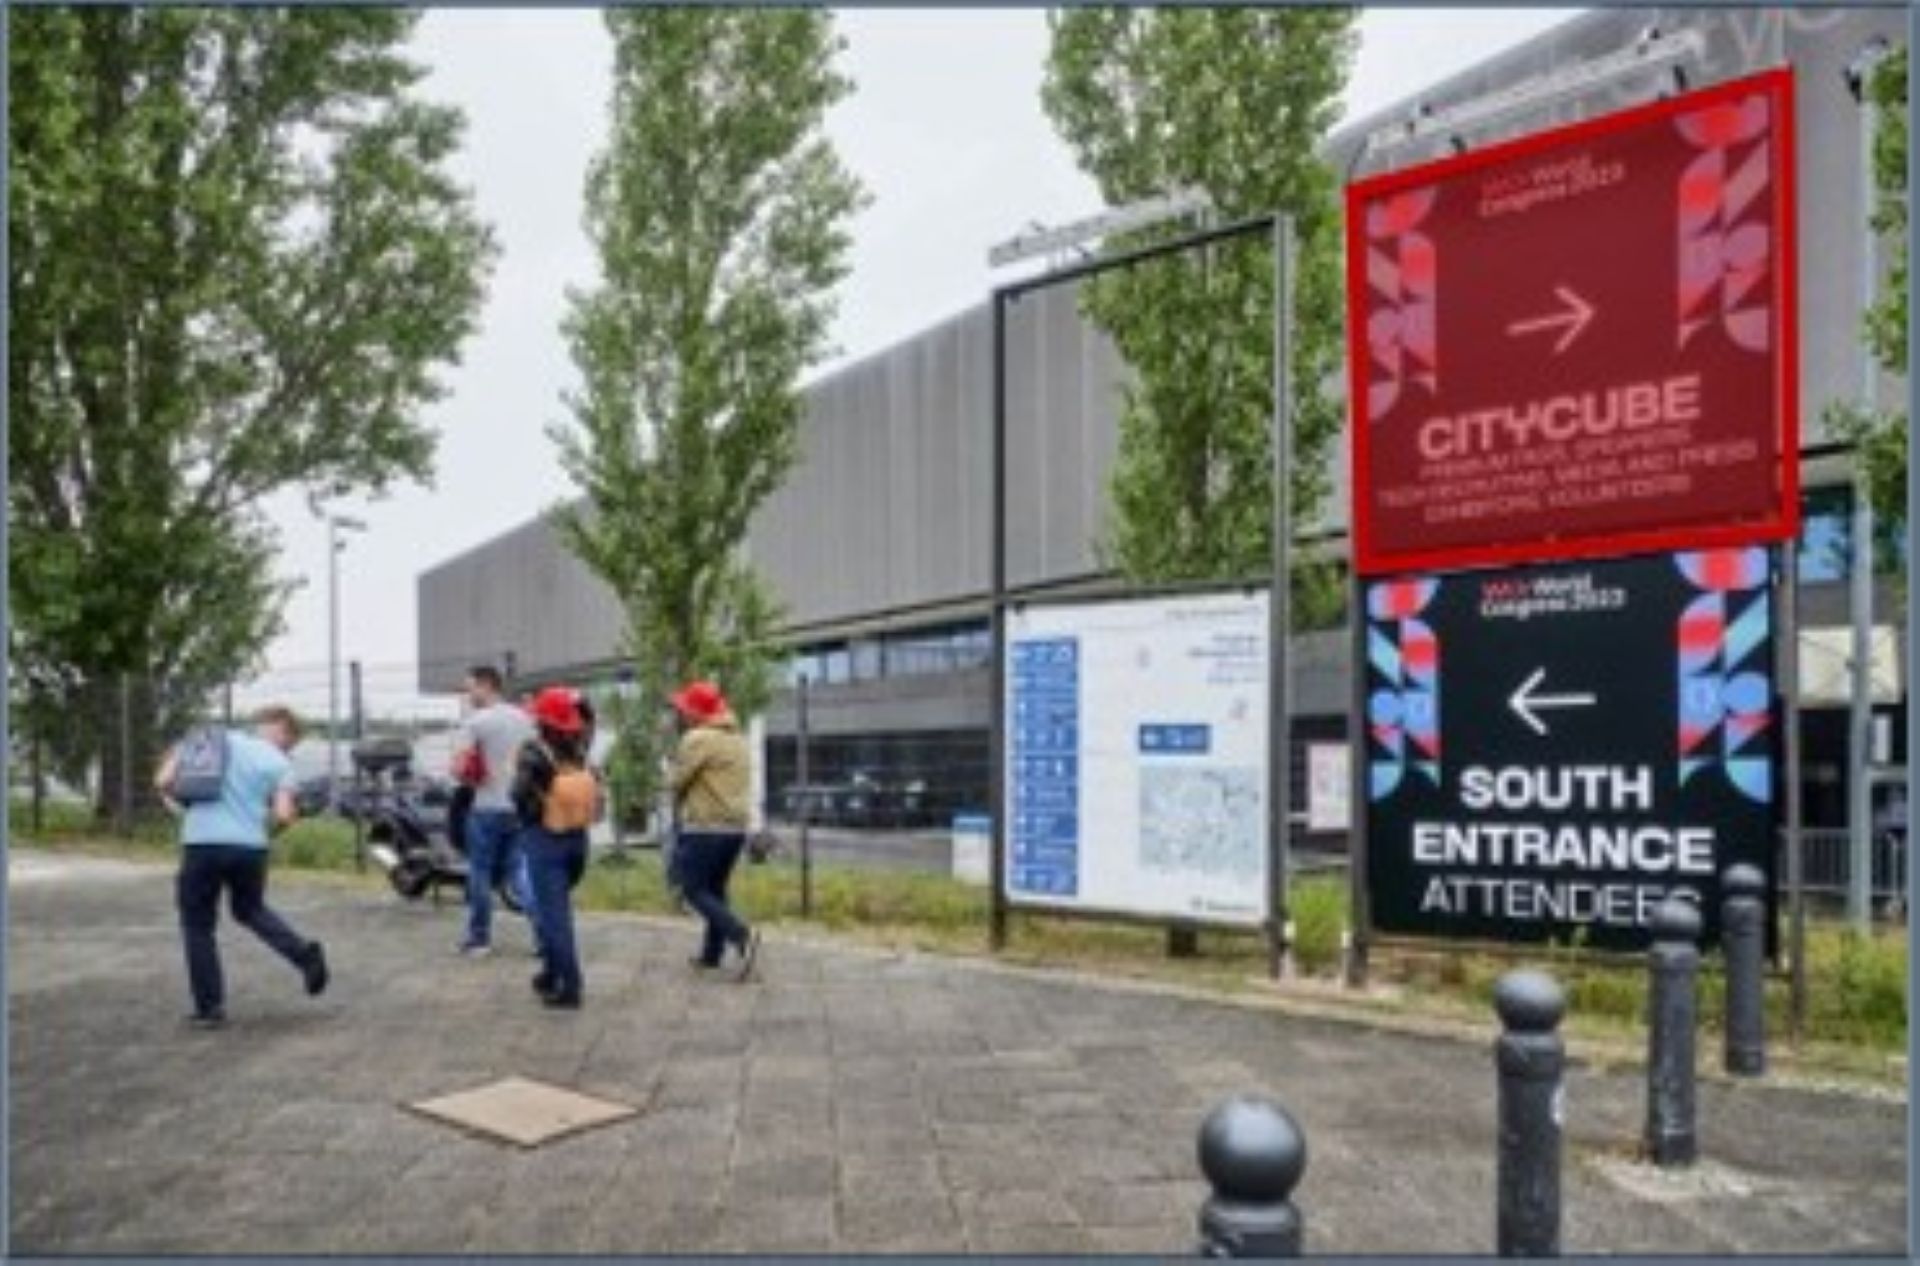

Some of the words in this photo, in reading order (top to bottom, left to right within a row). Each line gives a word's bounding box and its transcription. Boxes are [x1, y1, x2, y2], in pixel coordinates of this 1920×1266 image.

[1419, 374, 1701, 460] CITYCUBE
[1460, 764, 1652, 810] SOUTH
[1412, 822, 1716, 873] ENTRANCE
